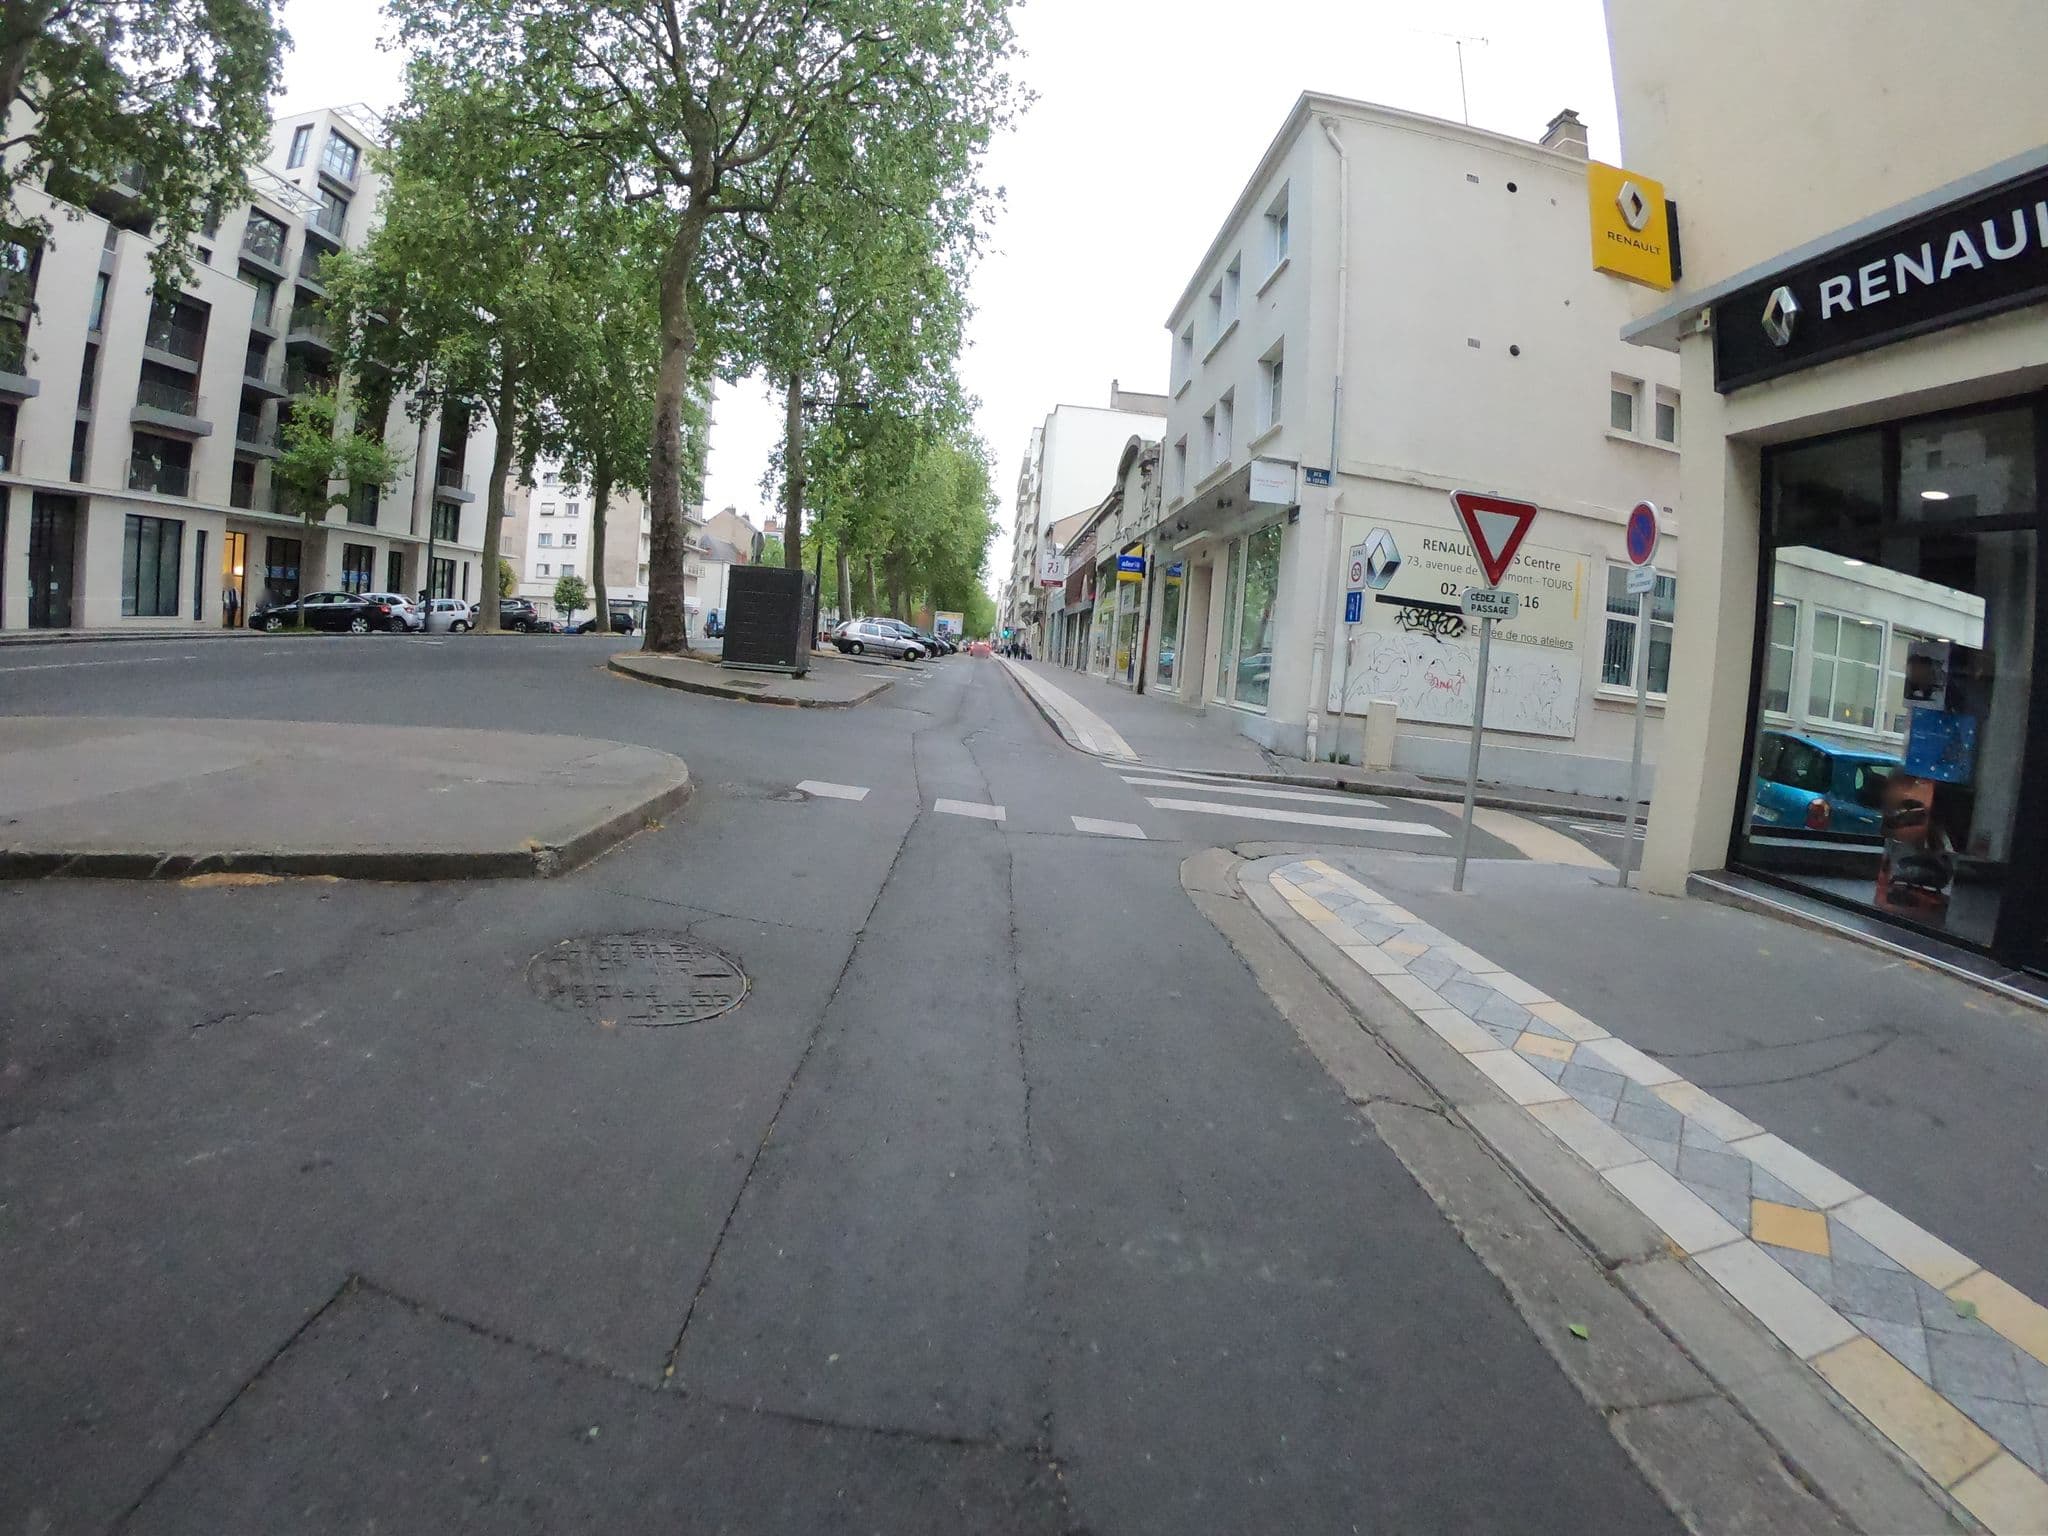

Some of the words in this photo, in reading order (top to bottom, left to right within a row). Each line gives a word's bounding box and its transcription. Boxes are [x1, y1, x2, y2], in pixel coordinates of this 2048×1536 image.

[1607, 231, 1661, 255] RENAULT
[1423, 538, 1473, 557] RENAUL
[1524, 555, 1561, 572] Centre
[1407, 555, 1422, 568] 73,
[1425, 560, 1463, 573] avenue
[1465, 564, 1478, 576] de
[1542, 576, 1573, 591] TOURS
[1470, 592, 1496, 603] CÉDEZ
[1501, 595, 1511, 605] LE
[1471, 603, 1509, 615] PASSAGE
[1505, 629, 1518, 641] de
[1520, 633, 1538, 644] nos
[1540, 635, 1574, 649] ateliers
